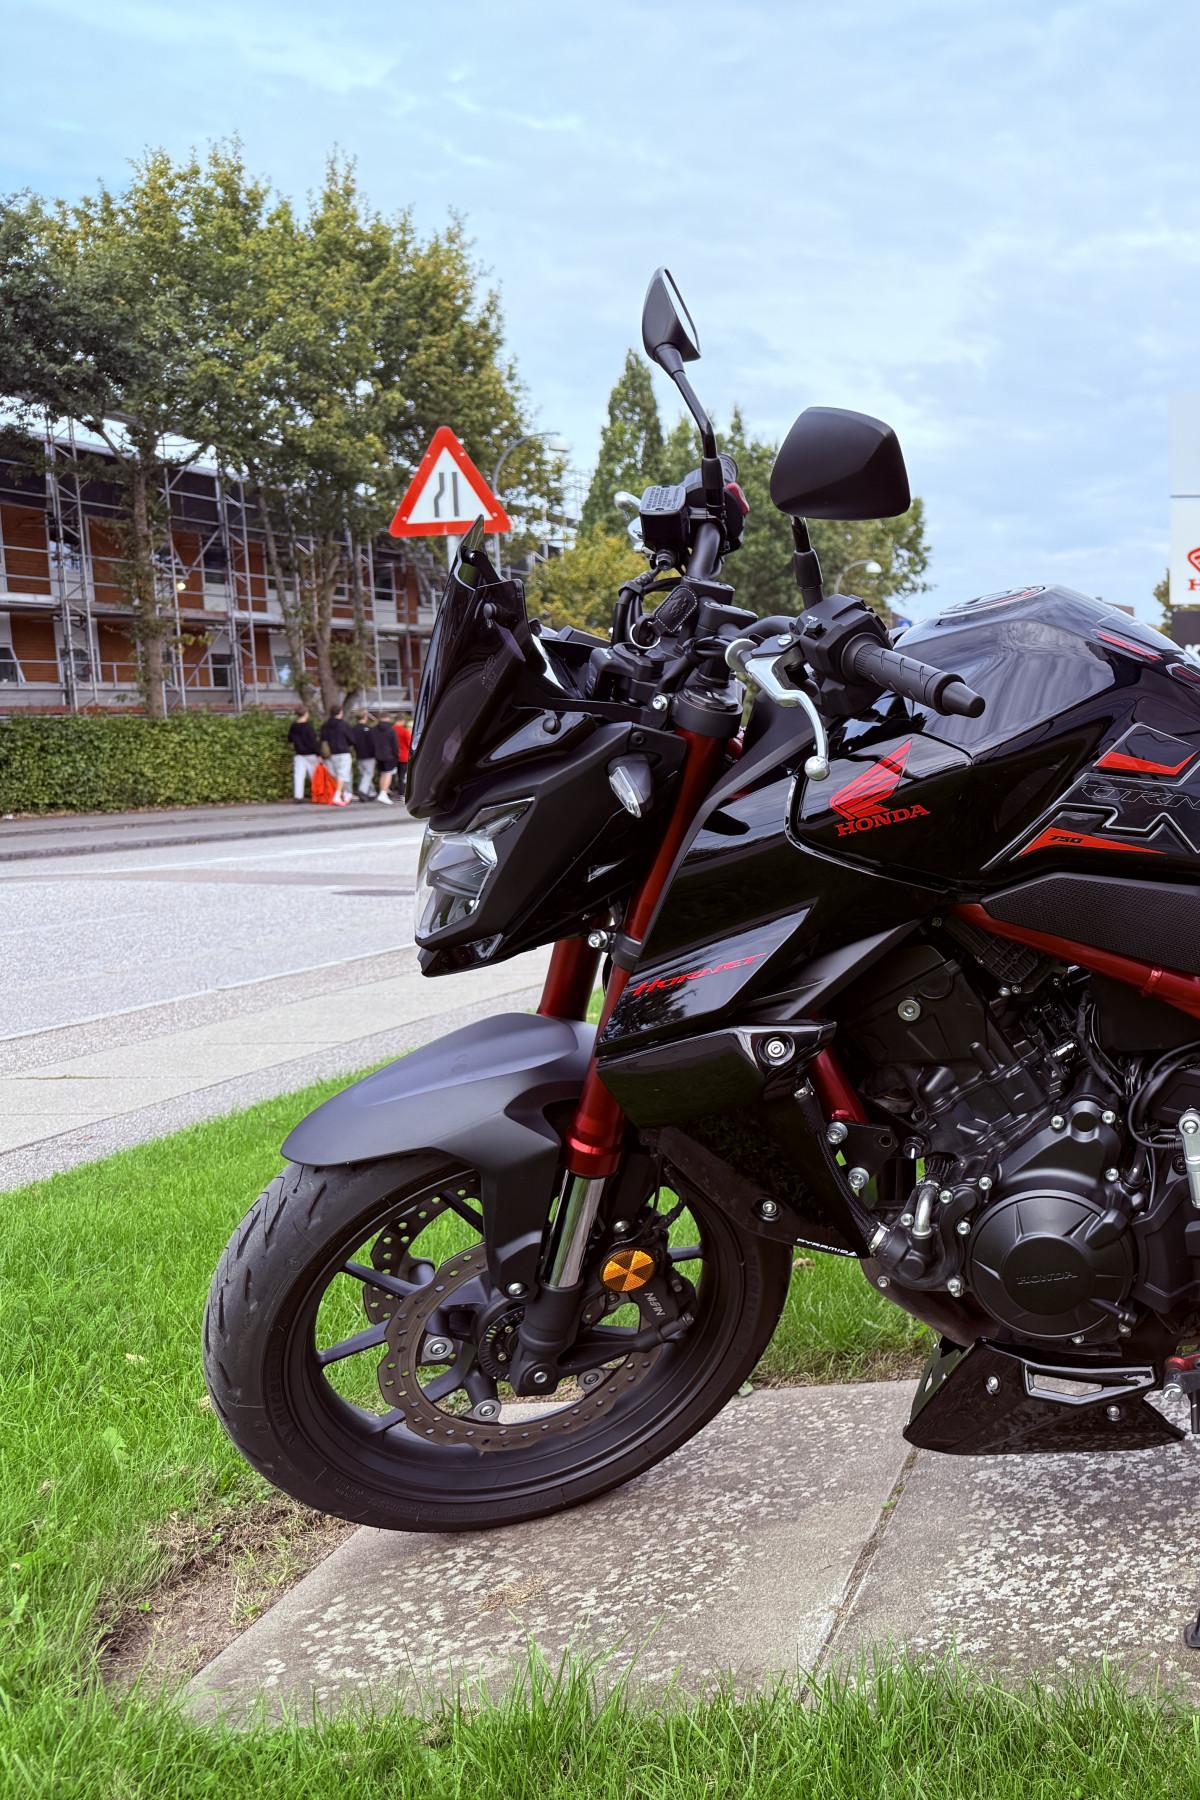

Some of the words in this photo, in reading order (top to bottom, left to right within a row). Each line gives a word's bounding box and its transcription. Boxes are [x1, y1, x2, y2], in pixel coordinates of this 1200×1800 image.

[834, 804, 931, 837] HONDA
[1048, 835, 1083, 844] 750
[632, 953, 767, 996] HORNET
